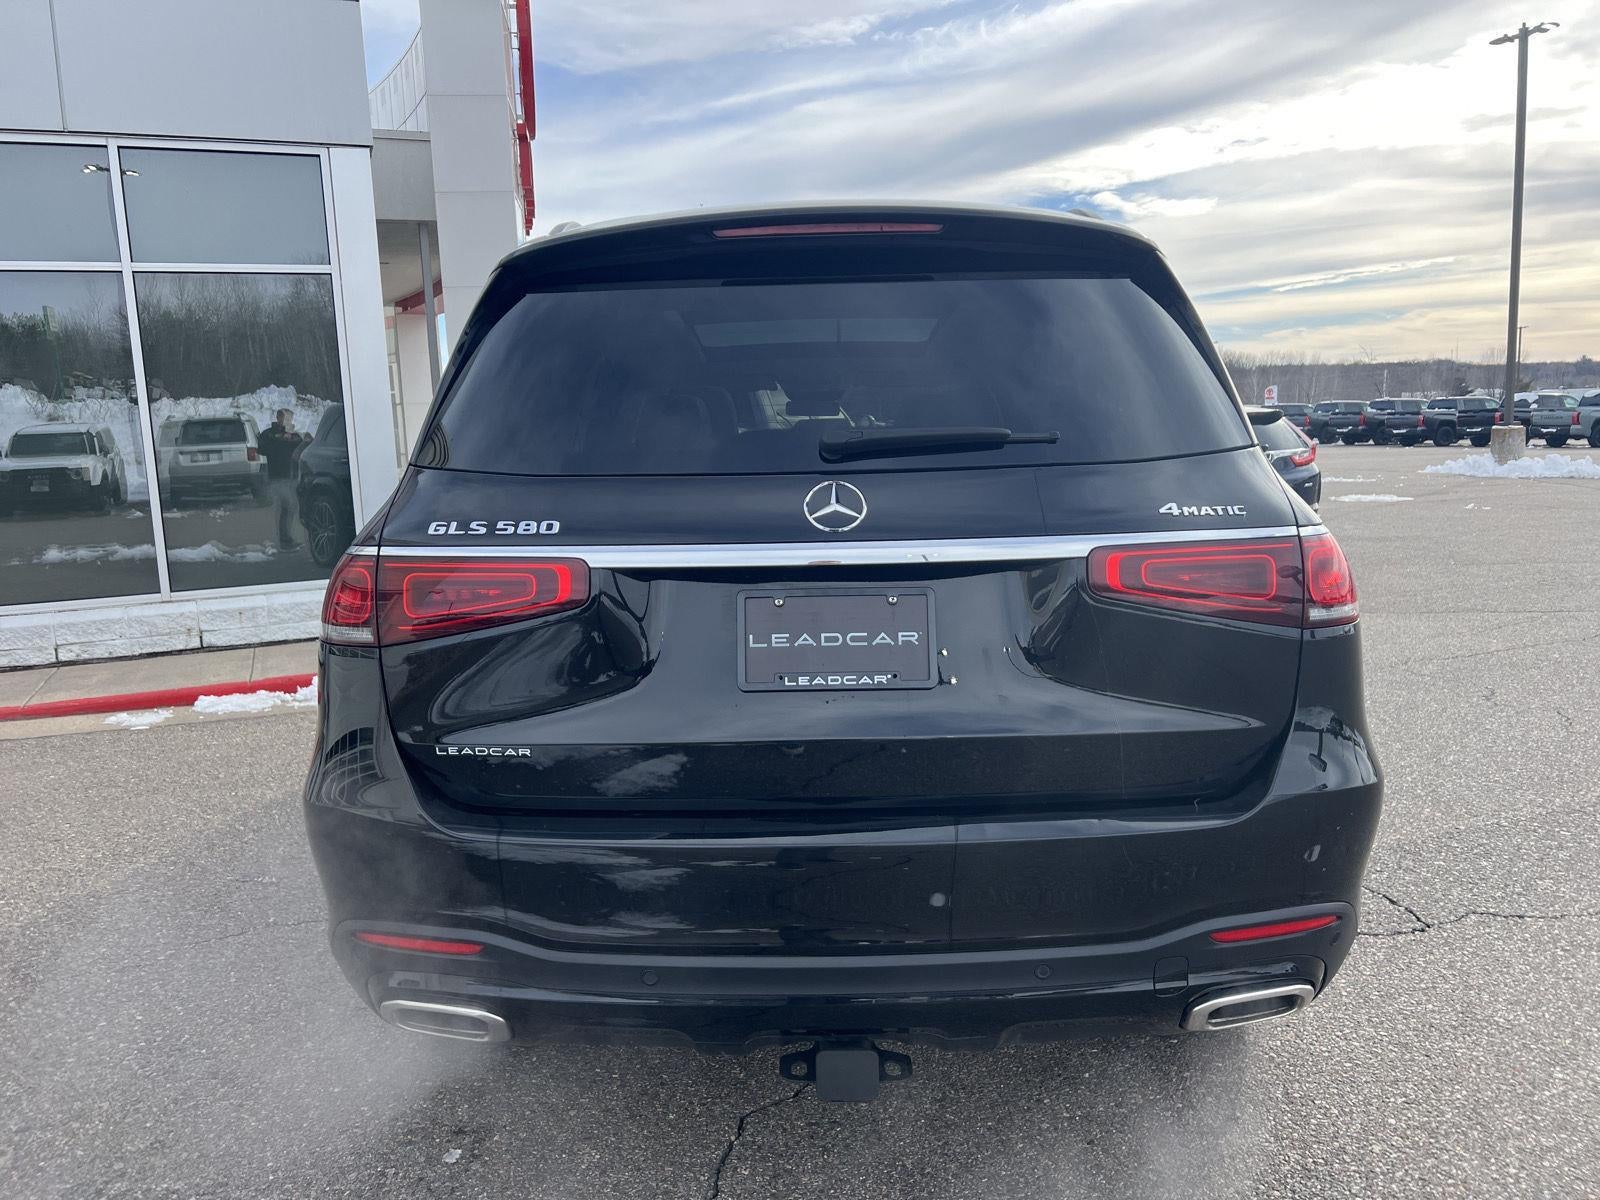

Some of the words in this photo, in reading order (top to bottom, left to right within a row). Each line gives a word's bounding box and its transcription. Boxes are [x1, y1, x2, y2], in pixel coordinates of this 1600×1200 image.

[1158, 502, 1247, 516] 4MATIC
[427, 520, 489, 535] GLS
[494, 519, 560, 535] 580
[748, 631, 919, 648] LEADCAR
[784, 674, 888, 686] LEADCAR
[435, 746, 531, 757] LEADCAR
